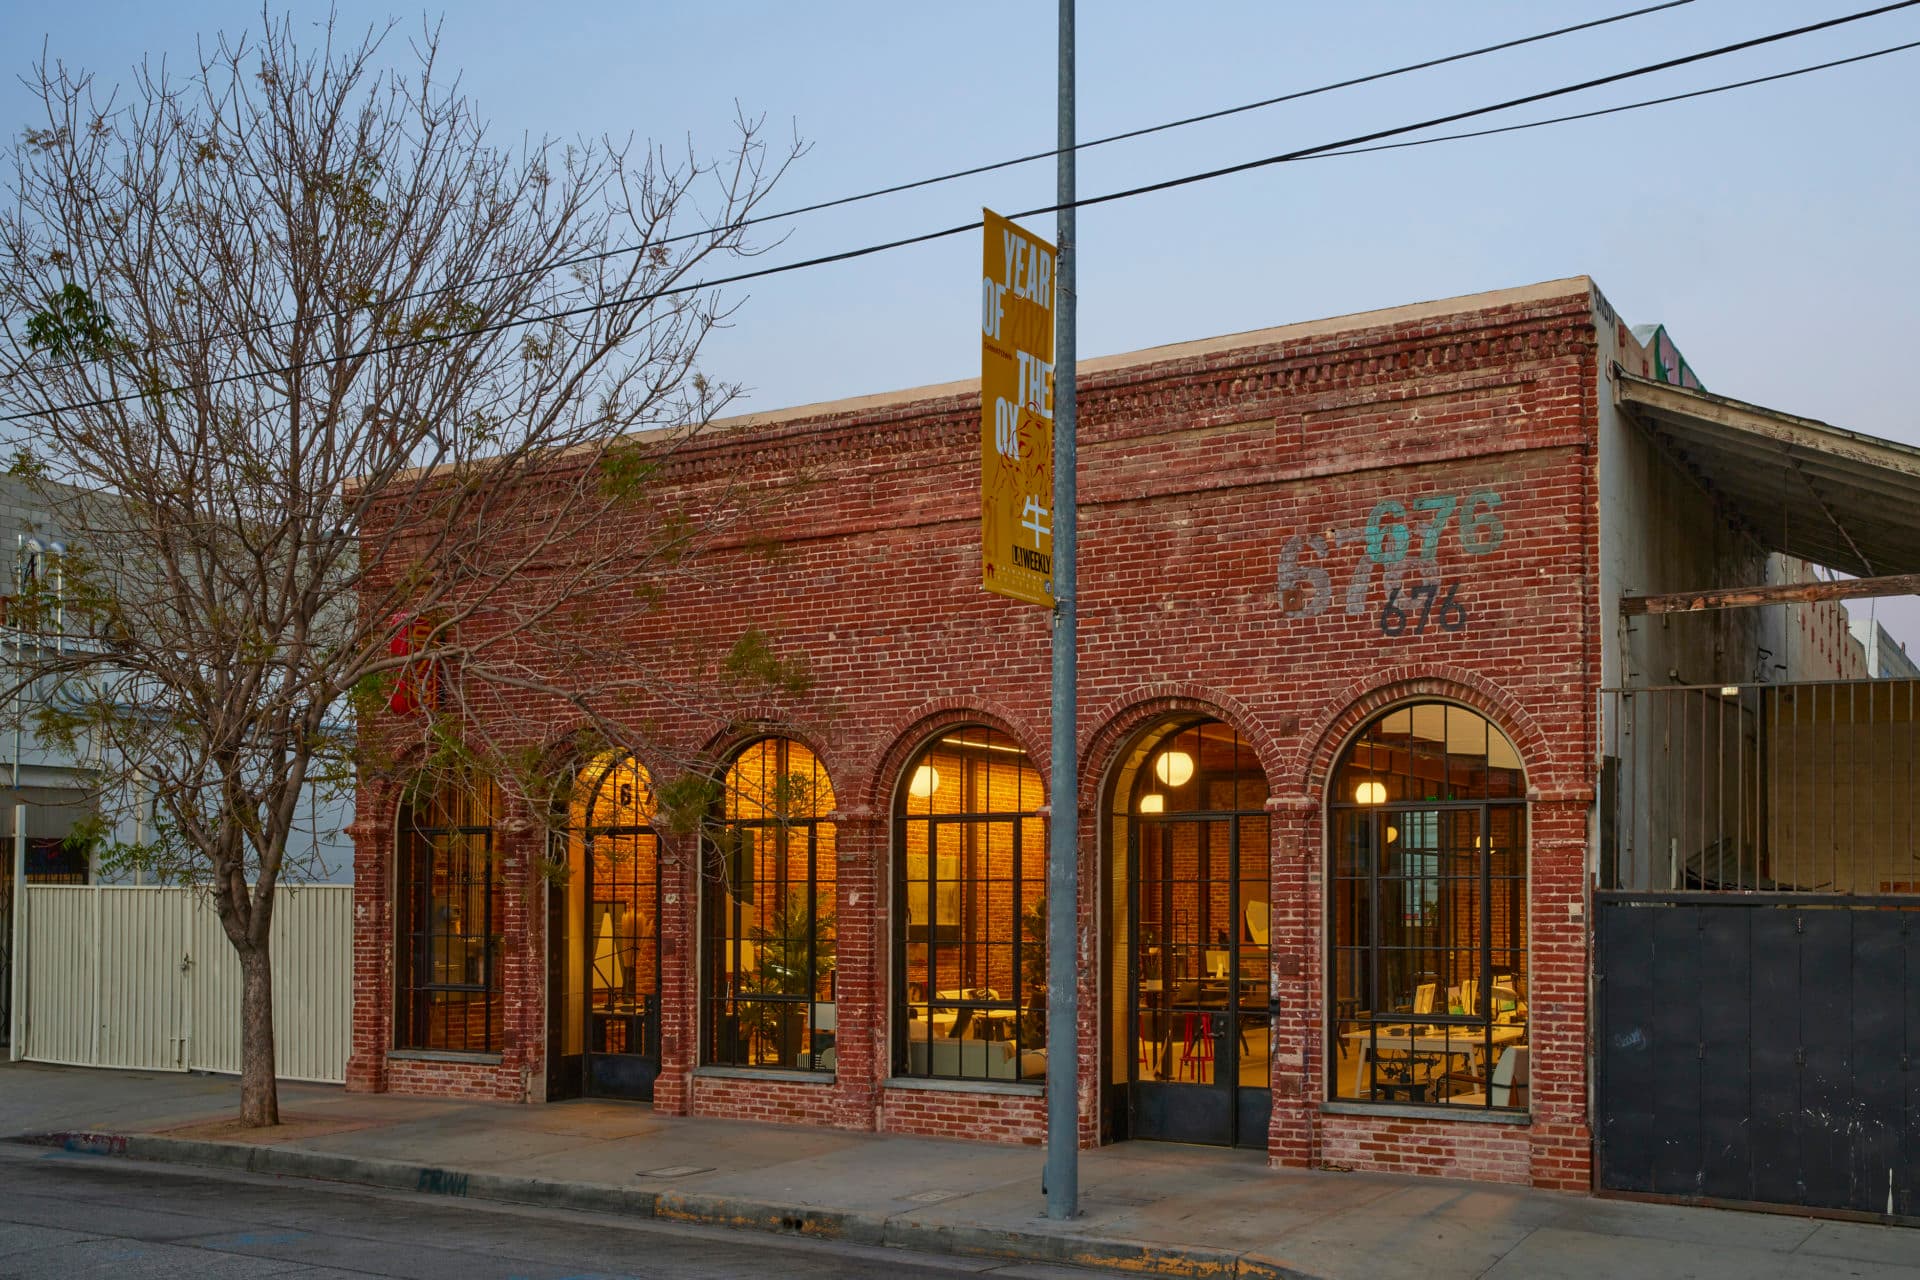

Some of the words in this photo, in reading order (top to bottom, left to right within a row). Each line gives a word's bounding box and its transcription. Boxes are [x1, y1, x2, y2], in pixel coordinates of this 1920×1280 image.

[1003, 228, 1051, 311] YEAR
[982, 276, 1006, 341] OF
[1016, 350, 1053, 419] THE
[995, 396, 1020, 461] OX
[1022, 494, 1051, 549] 牛
[1365, 488, 1504, 562] 676
[1023, 547, 1051, 575] WEEKLY
[1381, 582, 1467, 636] 676
